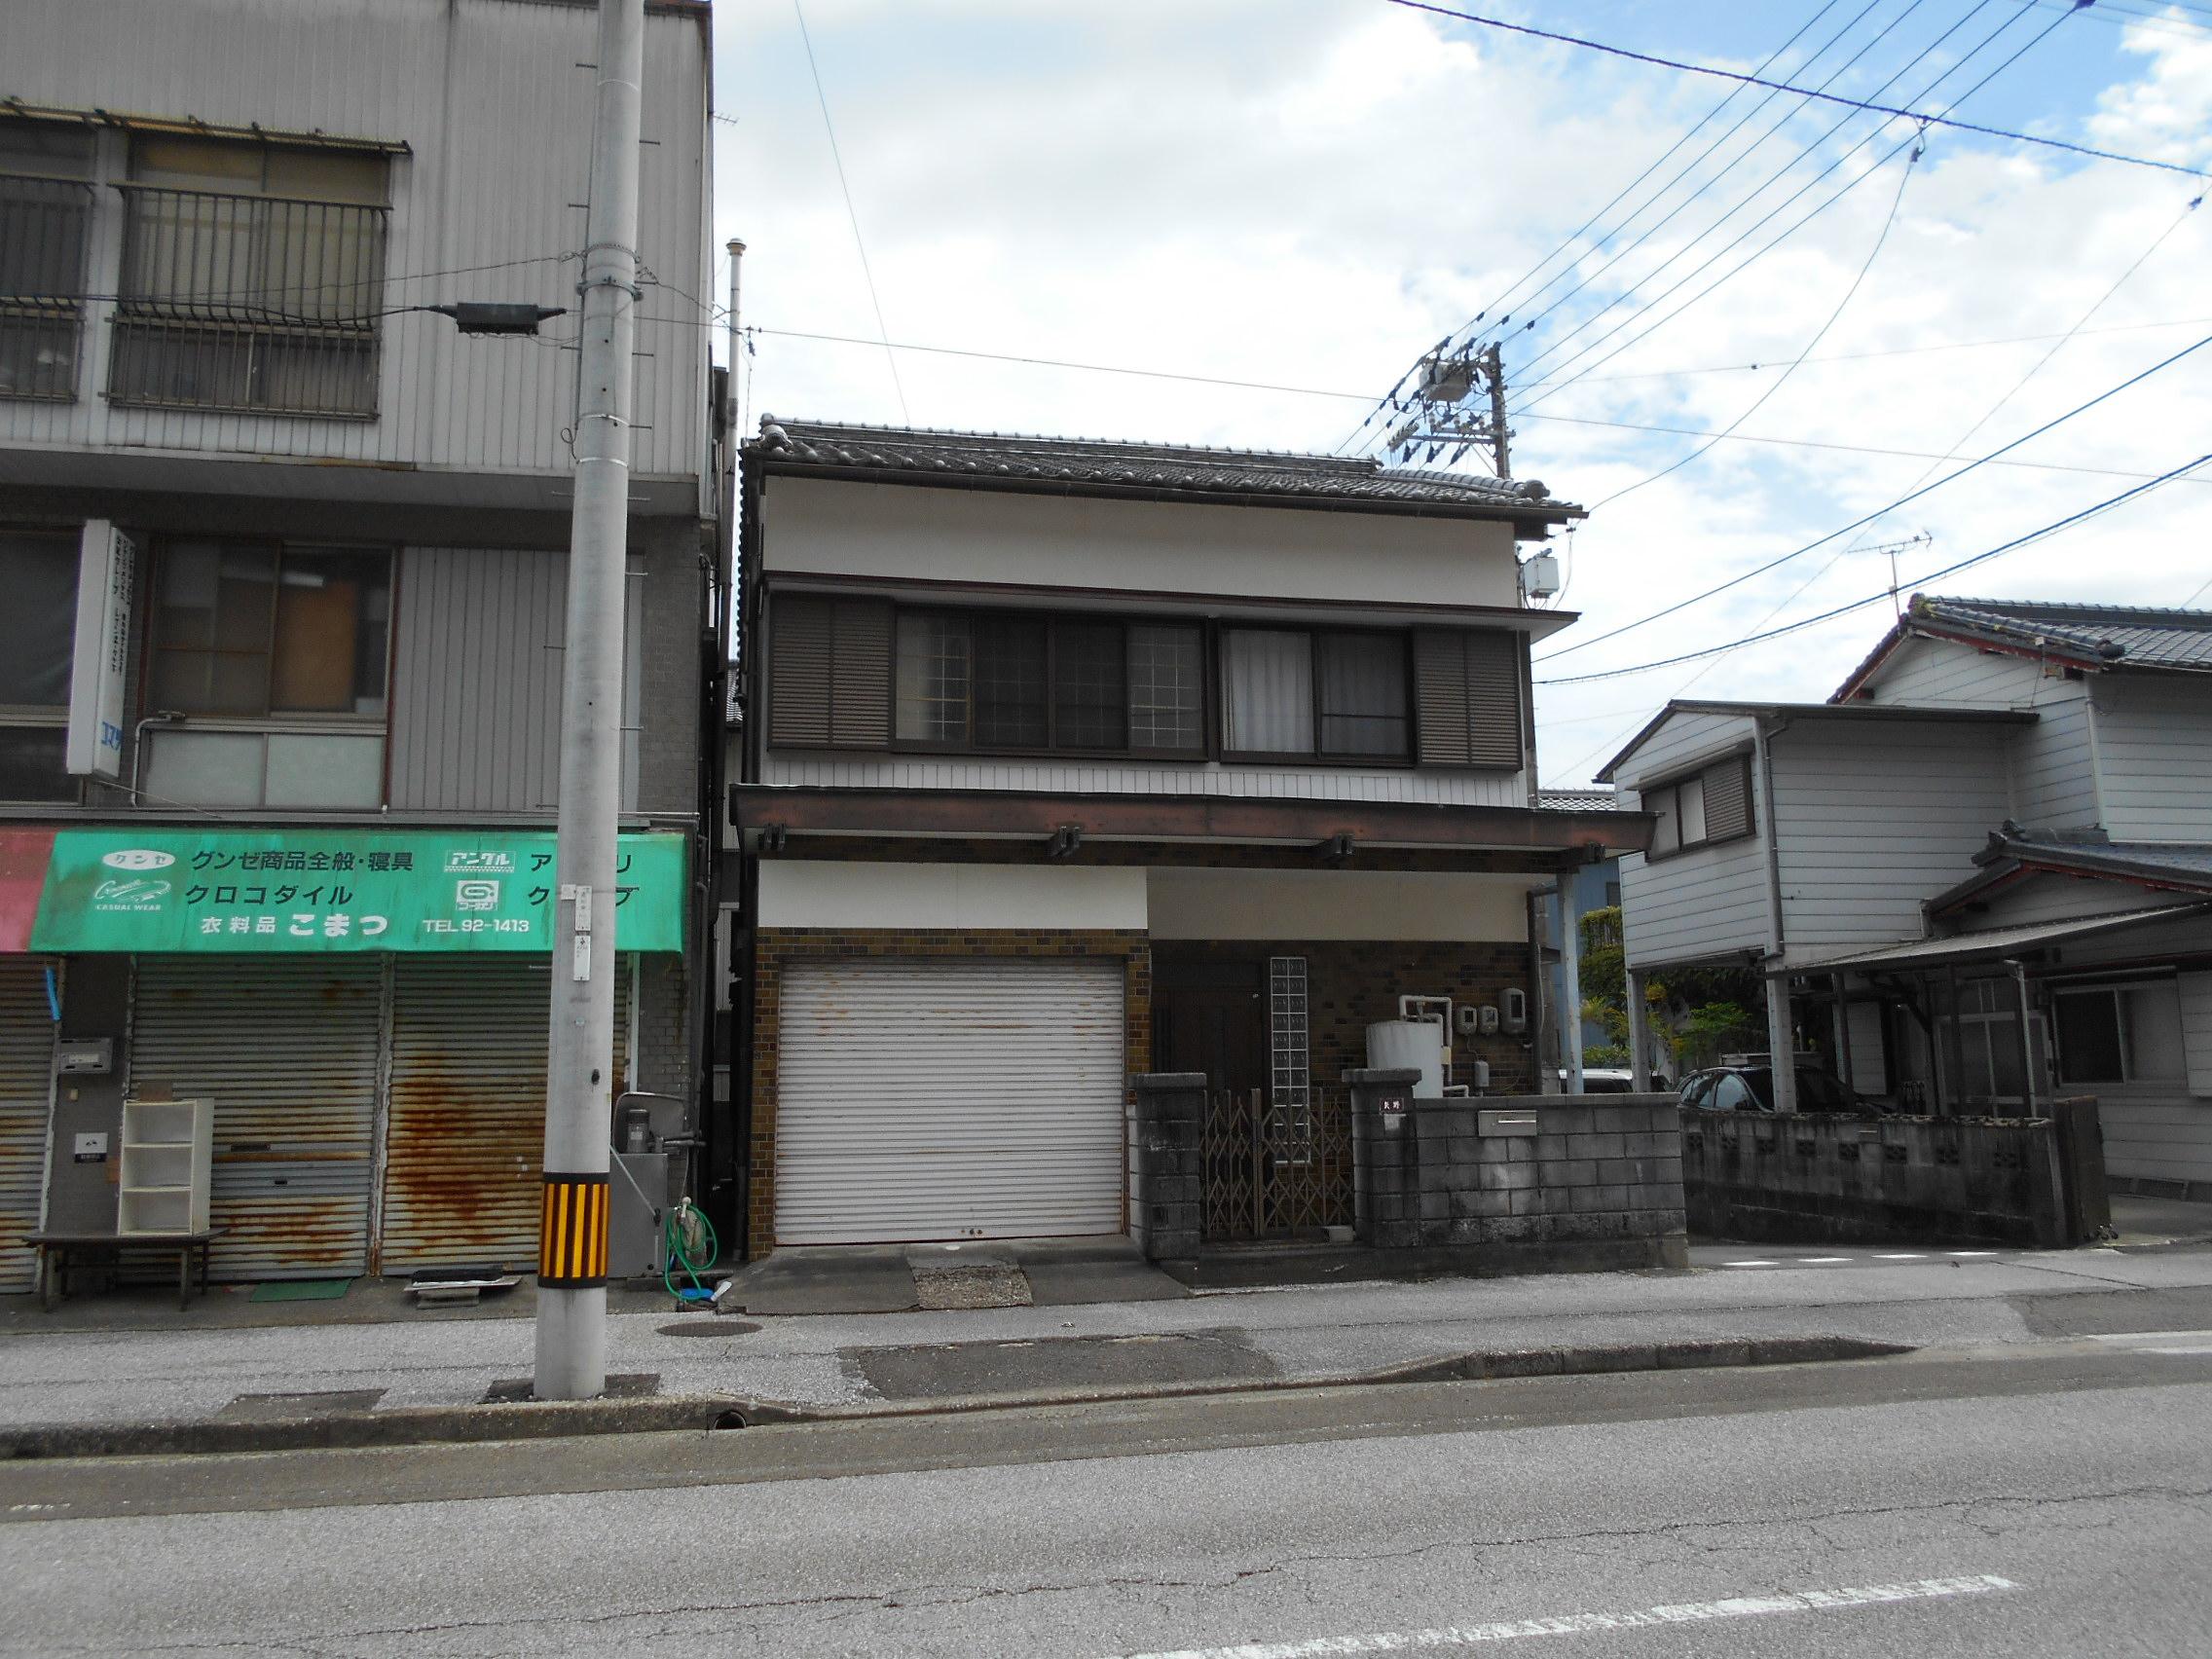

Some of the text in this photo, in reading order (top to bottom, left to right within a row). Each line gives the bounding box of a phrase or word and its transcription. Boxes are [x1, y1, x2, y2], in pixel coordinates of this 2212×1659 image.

[185, 884, 354, 905] クロコダイル
[201, 913, 388, 937] 衣料品 こまつ
[423, 919, 530, 933] TEL 92-1413
